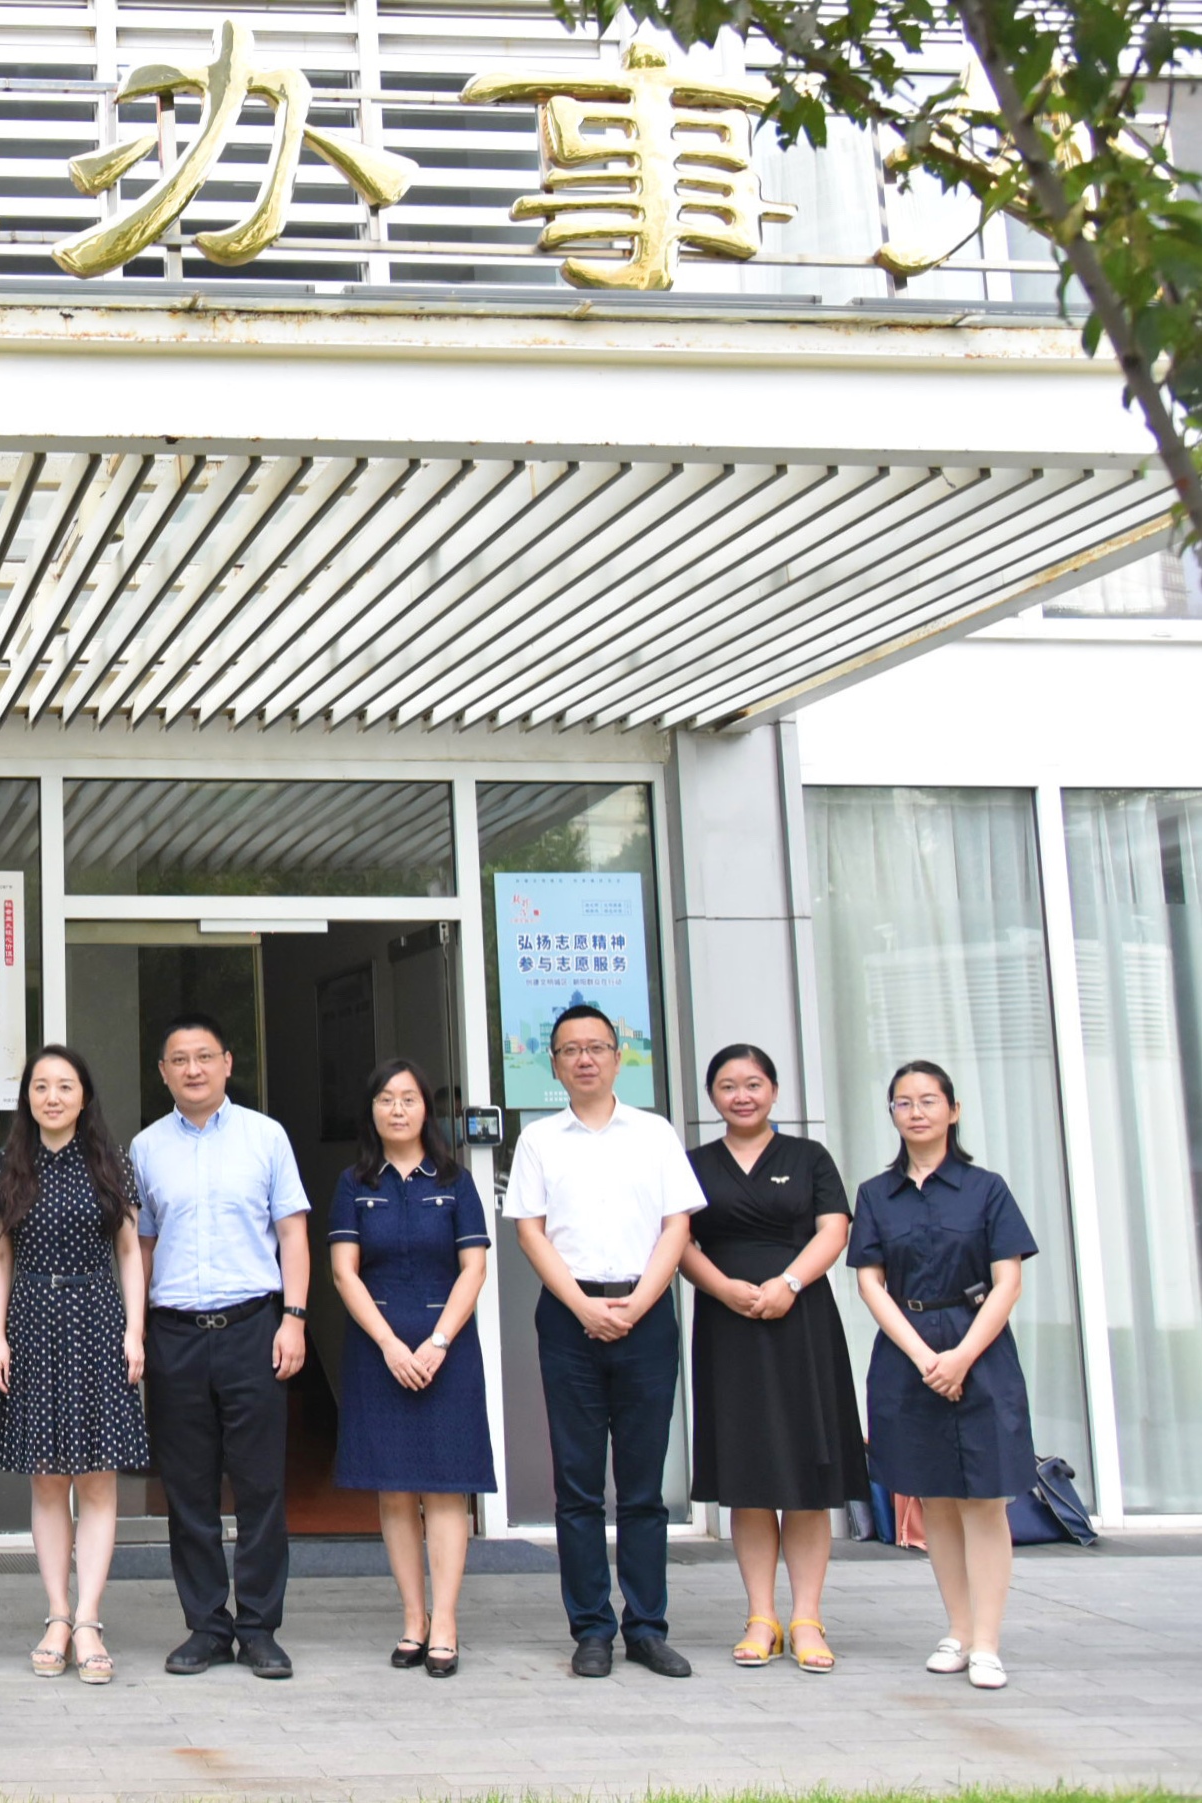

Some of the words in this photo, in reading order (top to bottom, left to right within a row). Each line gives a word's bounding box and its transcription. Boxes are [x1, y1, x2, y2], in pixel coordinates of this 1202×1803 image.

[518, 934, 626, 950] 弘扬志愿精神
[519, 956, 627, 972] 参与志愿服务
